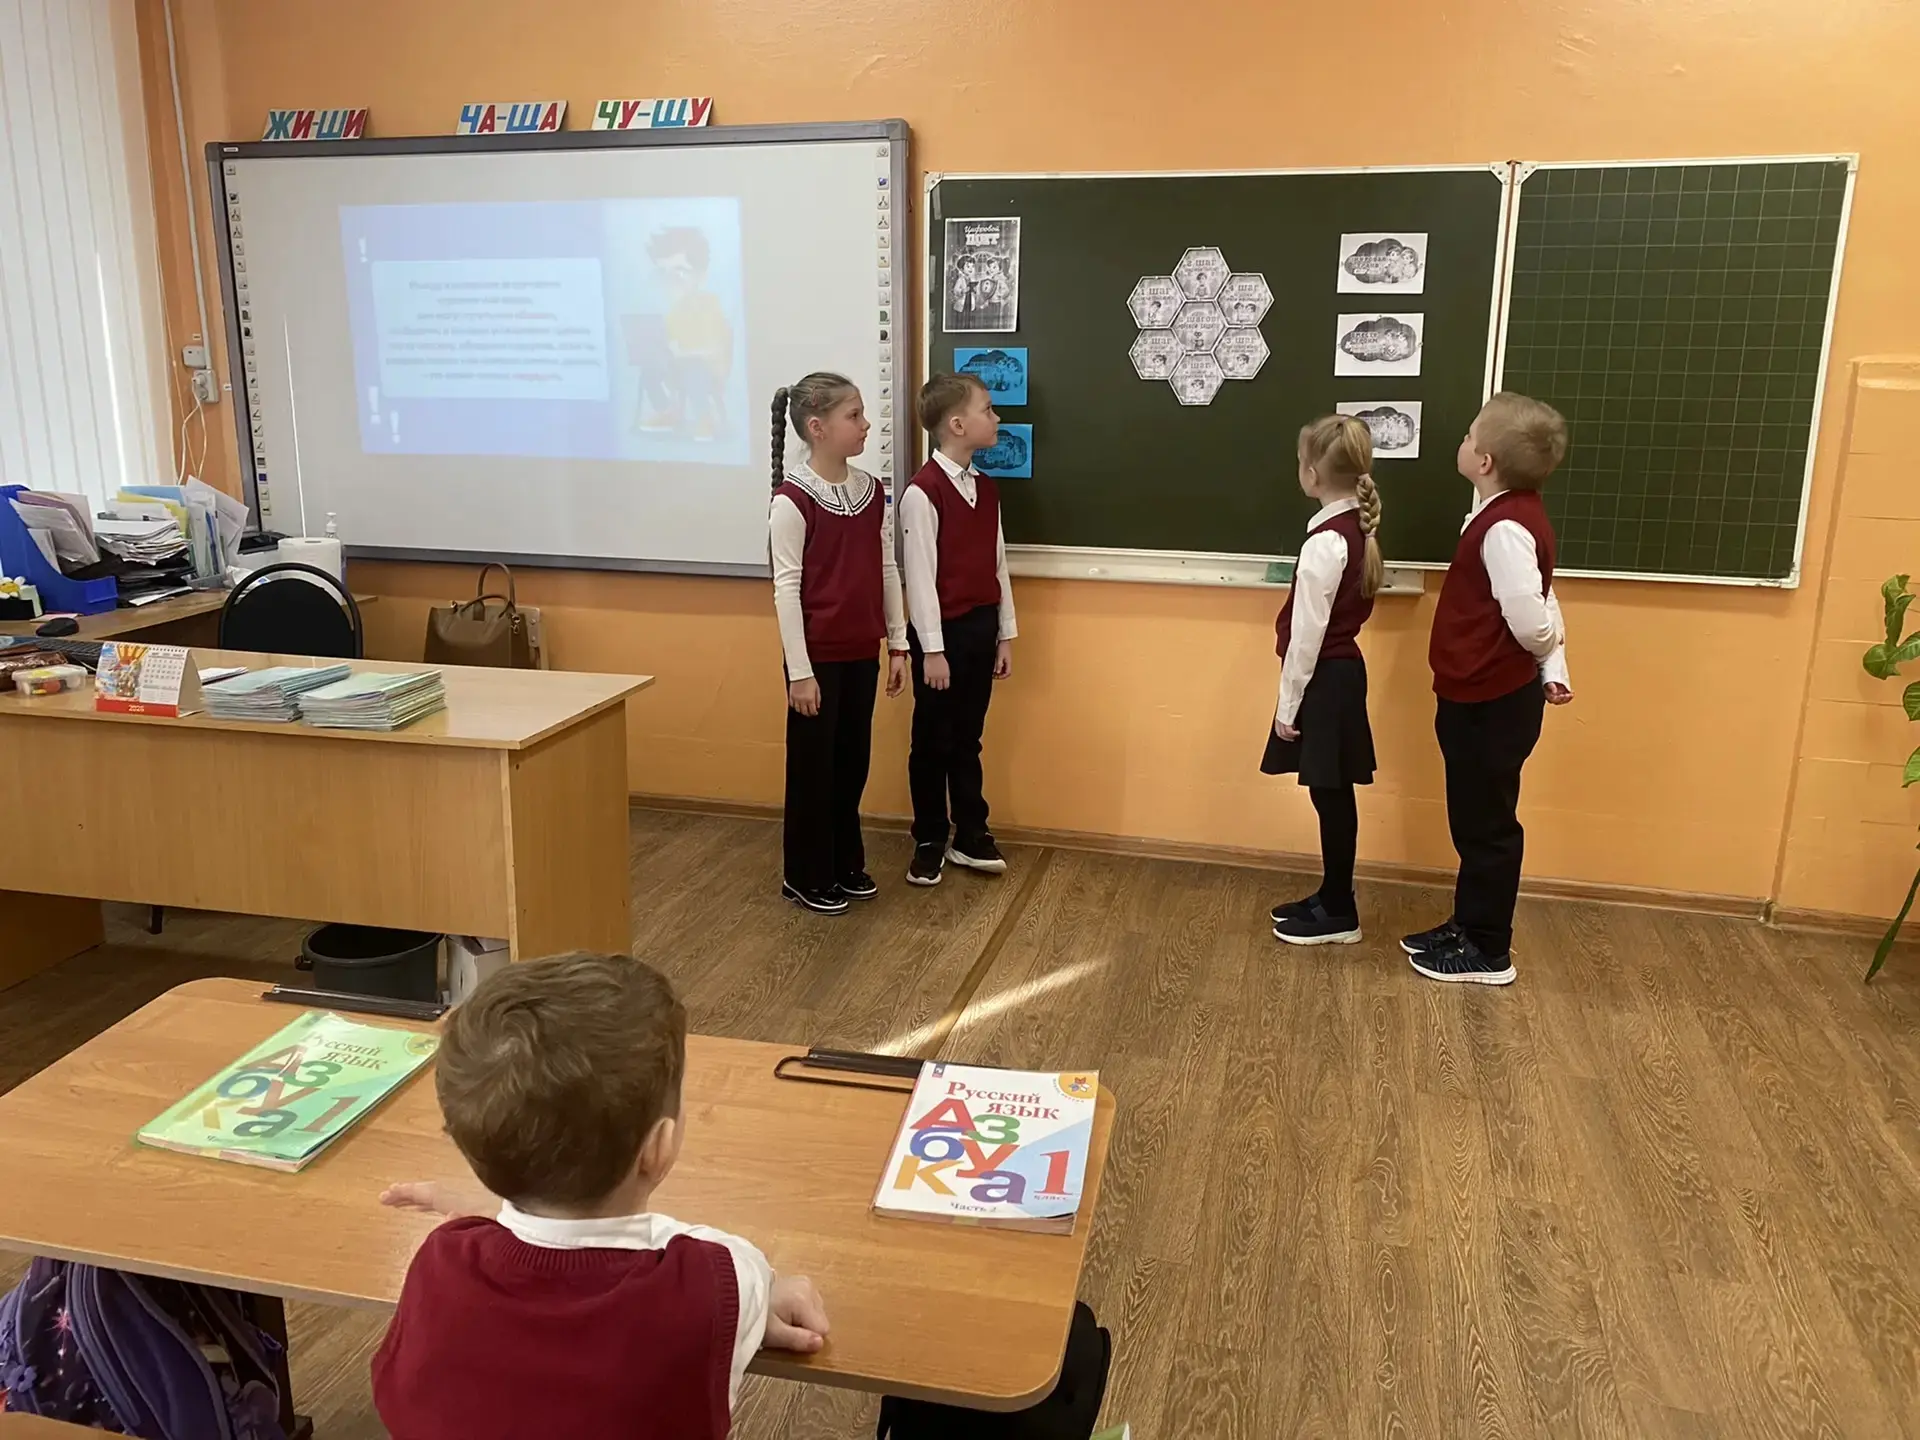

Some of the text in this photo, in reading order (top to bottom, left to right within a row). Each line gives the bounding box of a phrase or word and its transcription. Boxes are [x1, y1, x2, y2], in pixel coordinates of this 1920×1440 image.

[262, 109, 367, 139] ЖИ-ШИ
[300, 1031, 386, 1057] Русский
[946, 1081, 1041, 1105] Русский
[1033, 1150, 1073, 1196] 1
[950, 1202, 987, 1212] Часть
